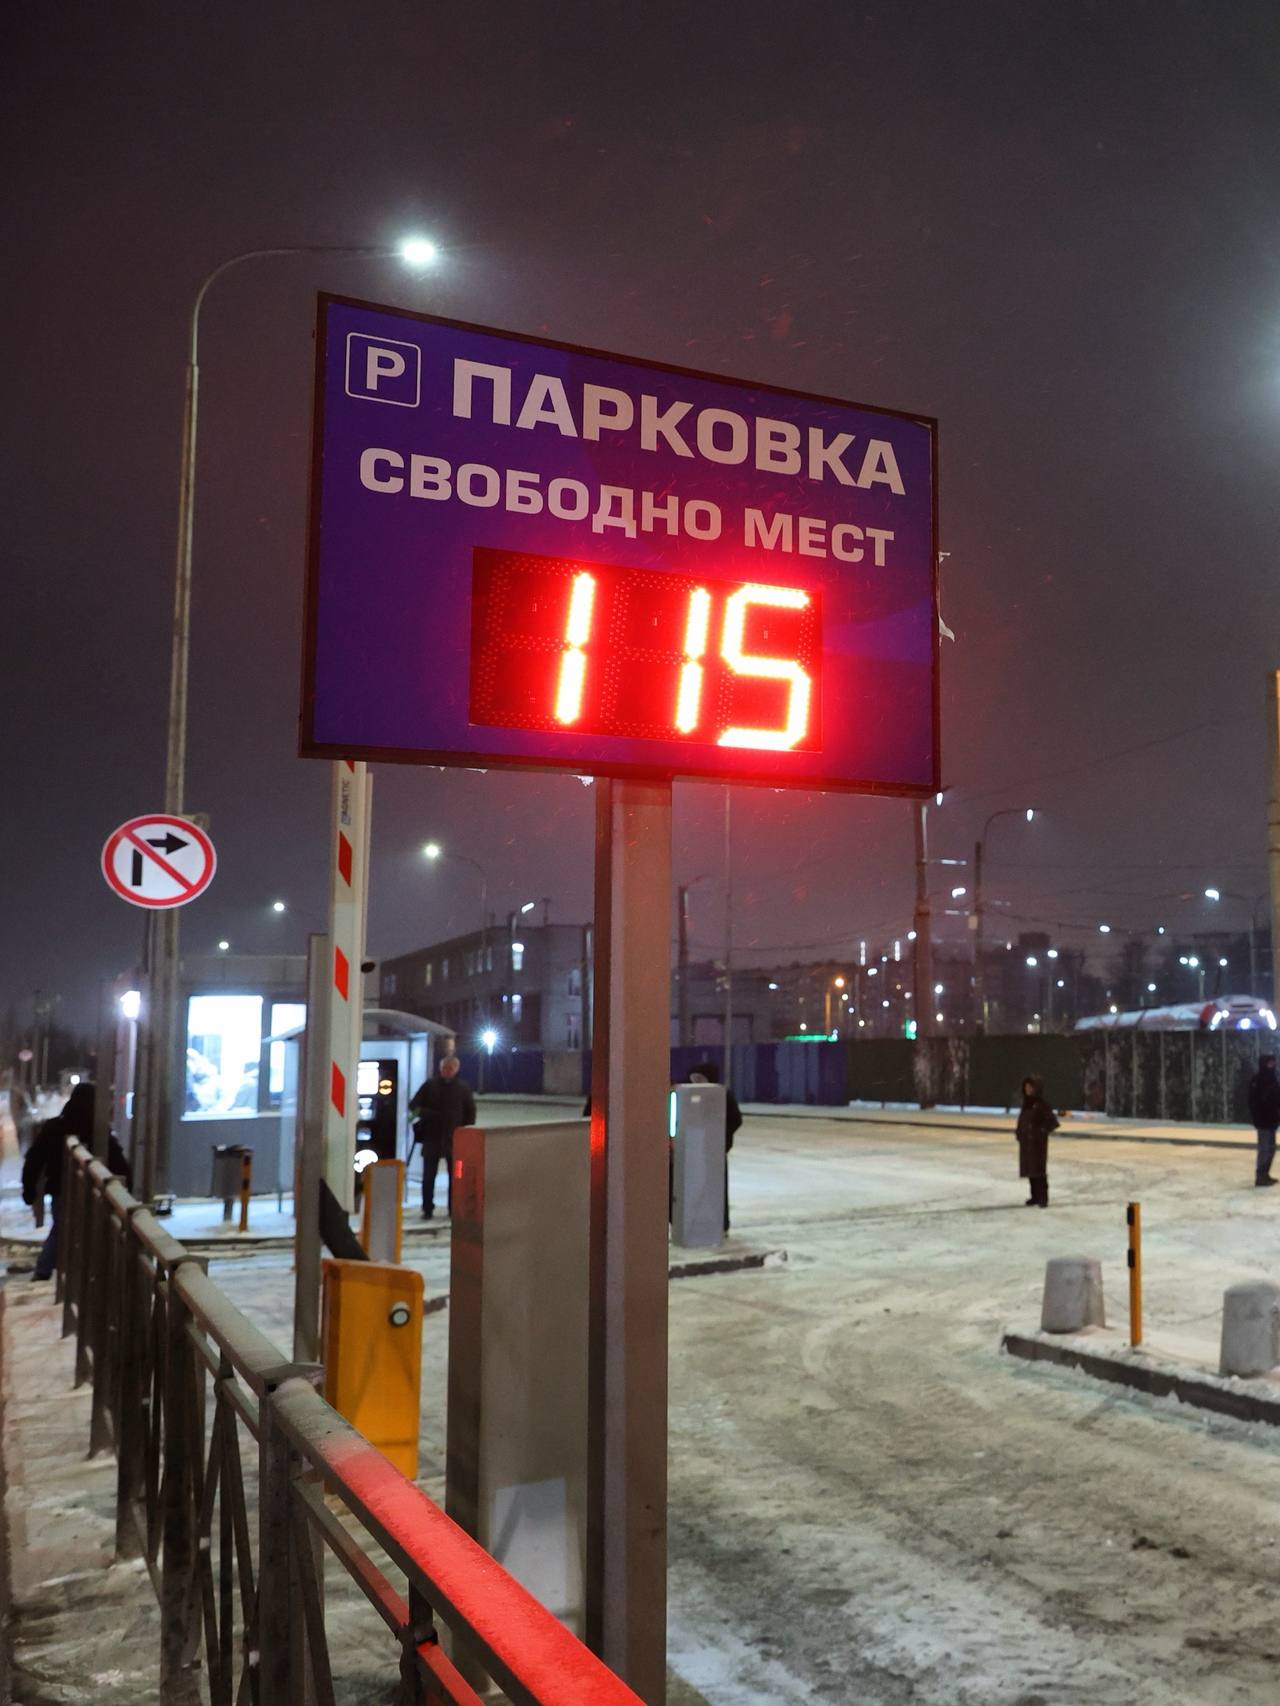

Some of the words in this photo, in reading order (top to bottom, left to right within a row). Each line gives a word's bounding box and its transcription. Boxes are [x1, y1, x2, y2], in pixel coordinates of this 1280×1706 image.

[365, 347, 406, 391] P
[453, 358, 906, 496] ПАРКОВКА
[359, 447, 722, 539] СВОБОДНО
[744, 508, 895, 567] МЕСТ
[555, 570, 813, 752] 115
